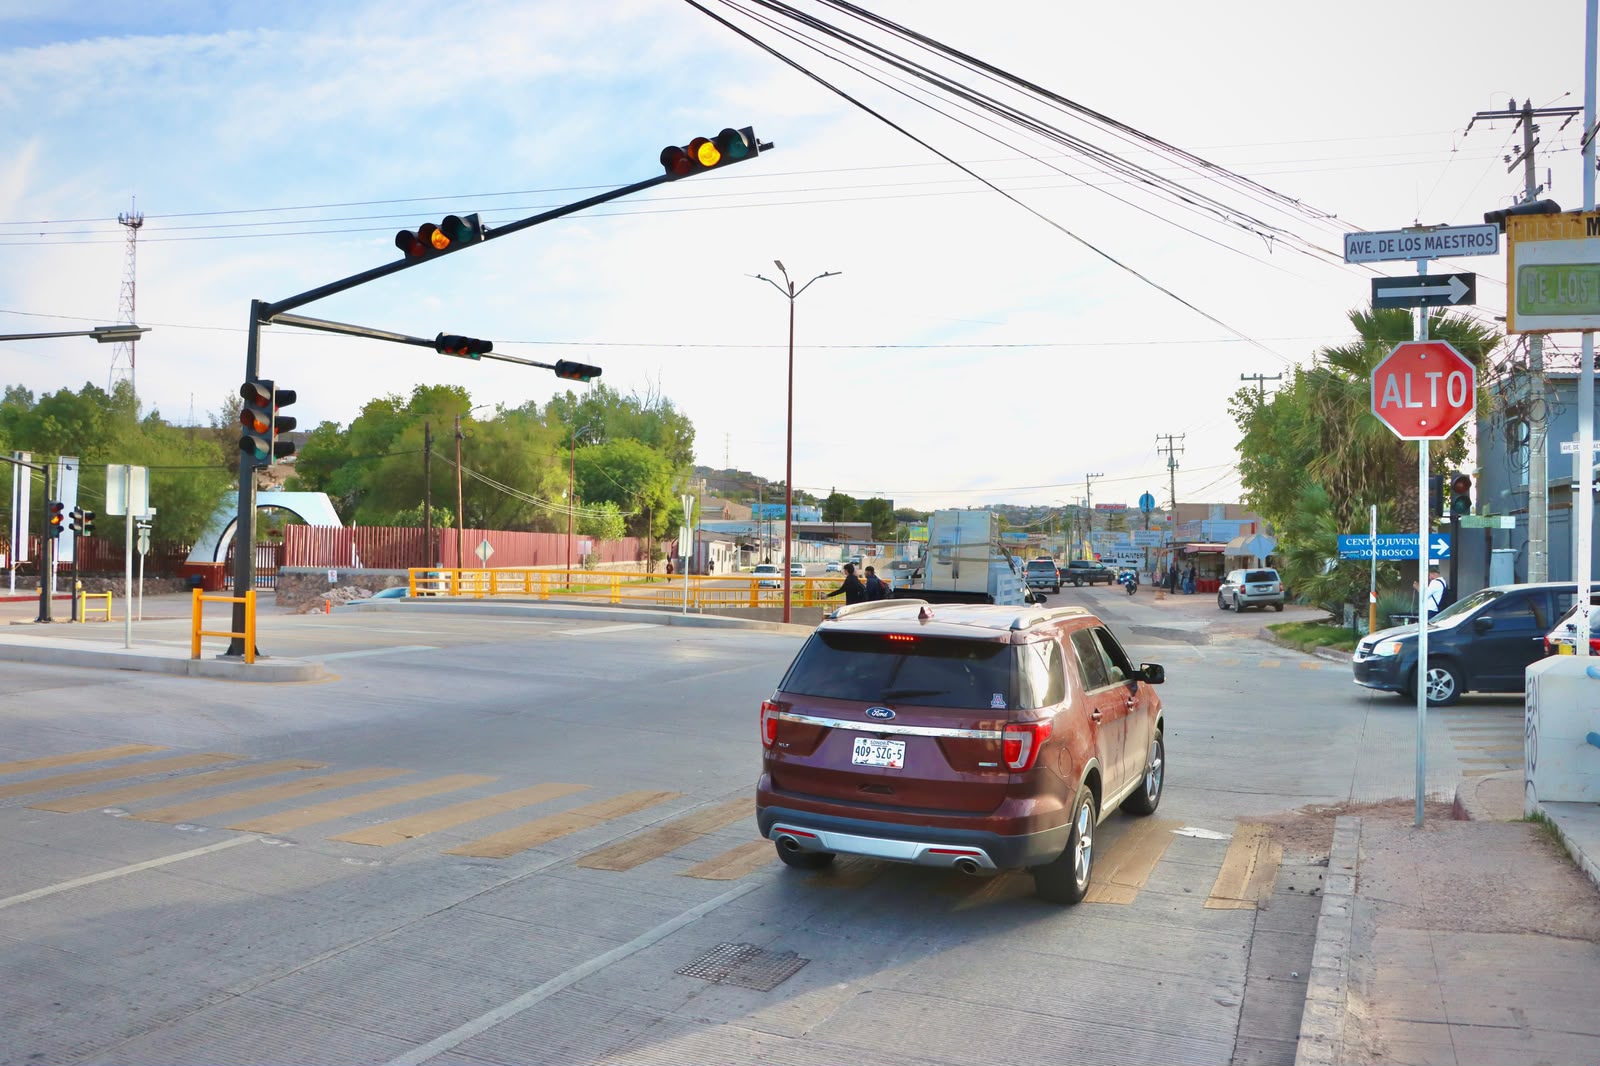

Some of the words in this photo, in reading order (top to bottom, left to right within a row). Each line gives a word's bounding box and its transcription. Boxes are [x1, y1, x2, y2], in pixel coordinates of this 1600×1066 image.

[1350, 241, 1375, 255] AVE.
[1379, 240, 1395, 252] DE
[1399, 237, 1421, 252] LOS
[1425, 232, 1493, 250] MAESTROS
[1527, 272, 1547, 304] DE
[1558, 272, 1588, 304] LOS
[1381, 371, 1467, 409] ALTO
[1385, 538, 1419, 546] JUVENI
[1382, 549, 1413, 557] BOSCO
[871, 709, 889, 718] Ford
[855, 745, 903, 760] 409-SZG-5
